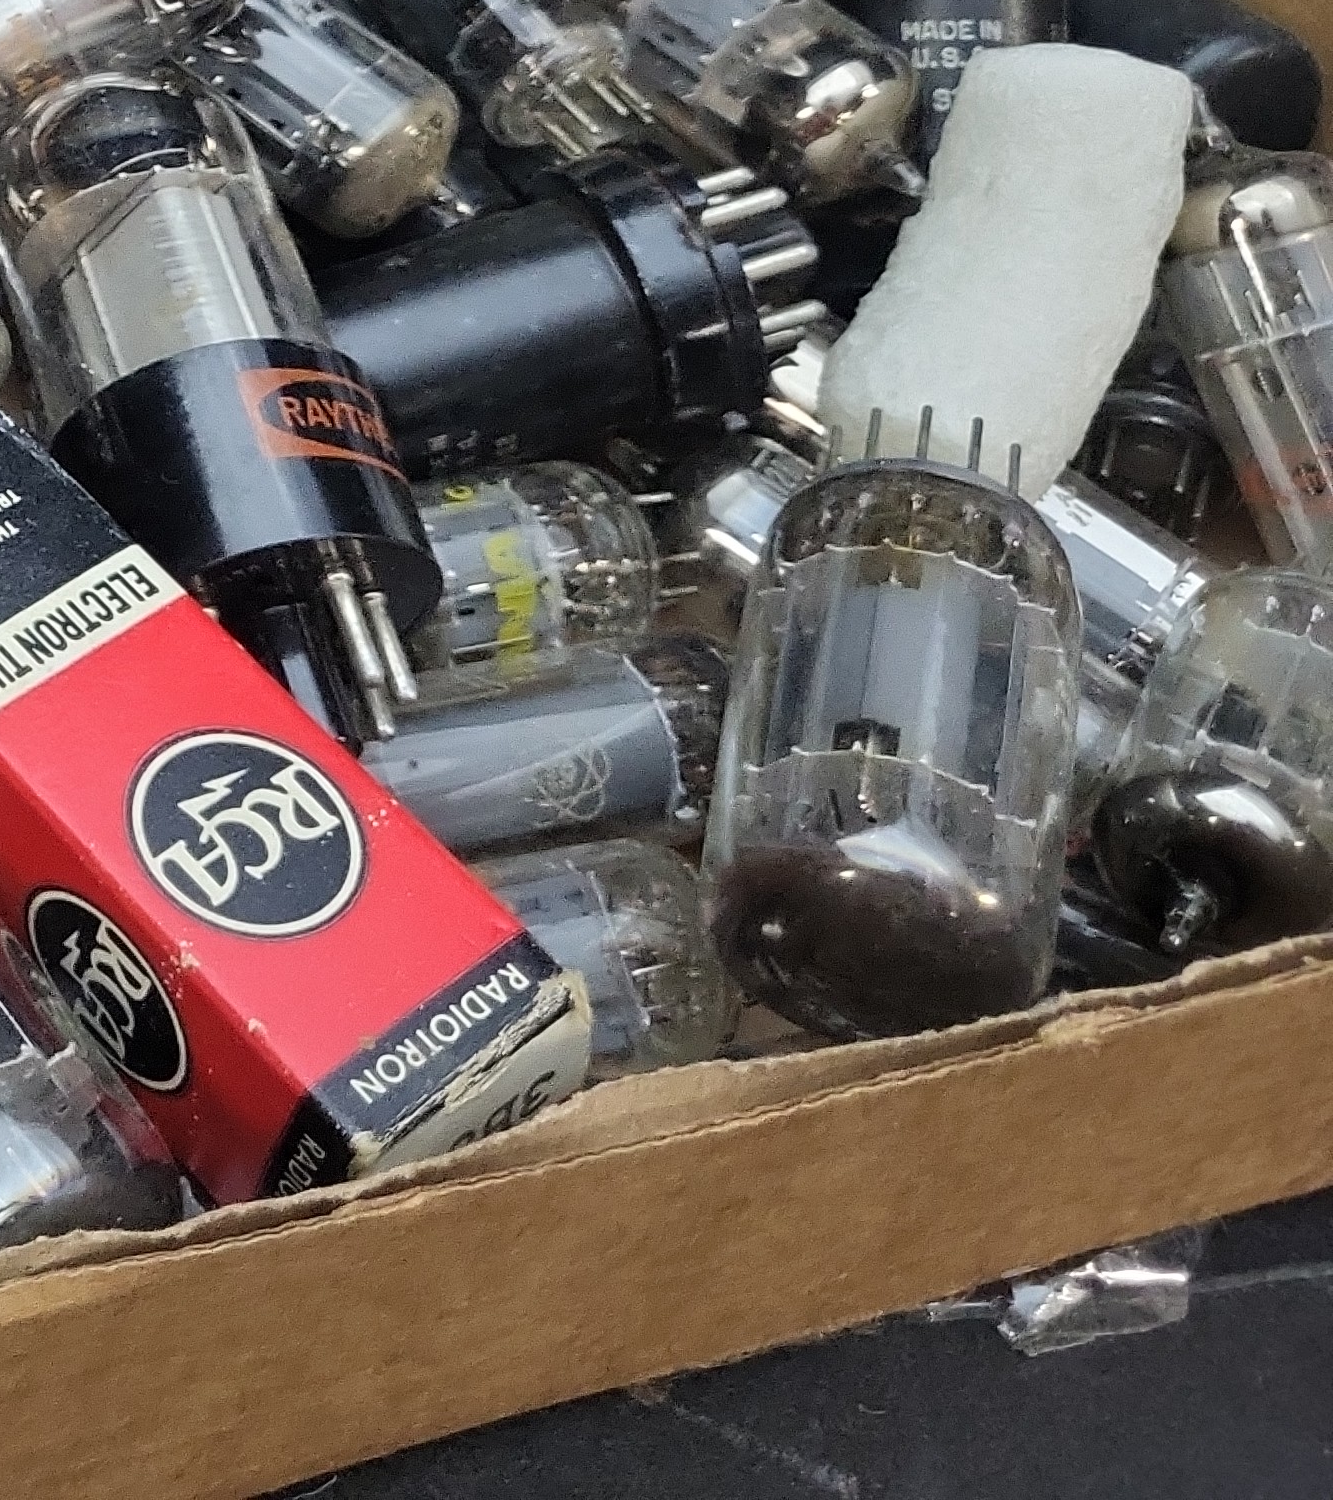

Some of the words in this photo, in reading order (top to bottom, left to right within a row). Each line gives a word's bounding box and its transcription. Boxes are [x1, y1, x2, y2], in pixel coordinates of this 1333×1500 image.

[900, 19, 976, 42] MADE
[979, 19, 1003, 41] IN
[11, 562, 161, 666] ELECTRON
[150, 762, 341, 908] RCA
[73, 920, 155, 1062] RCA
[349, 962, 530, 1106] RADIOTRON
